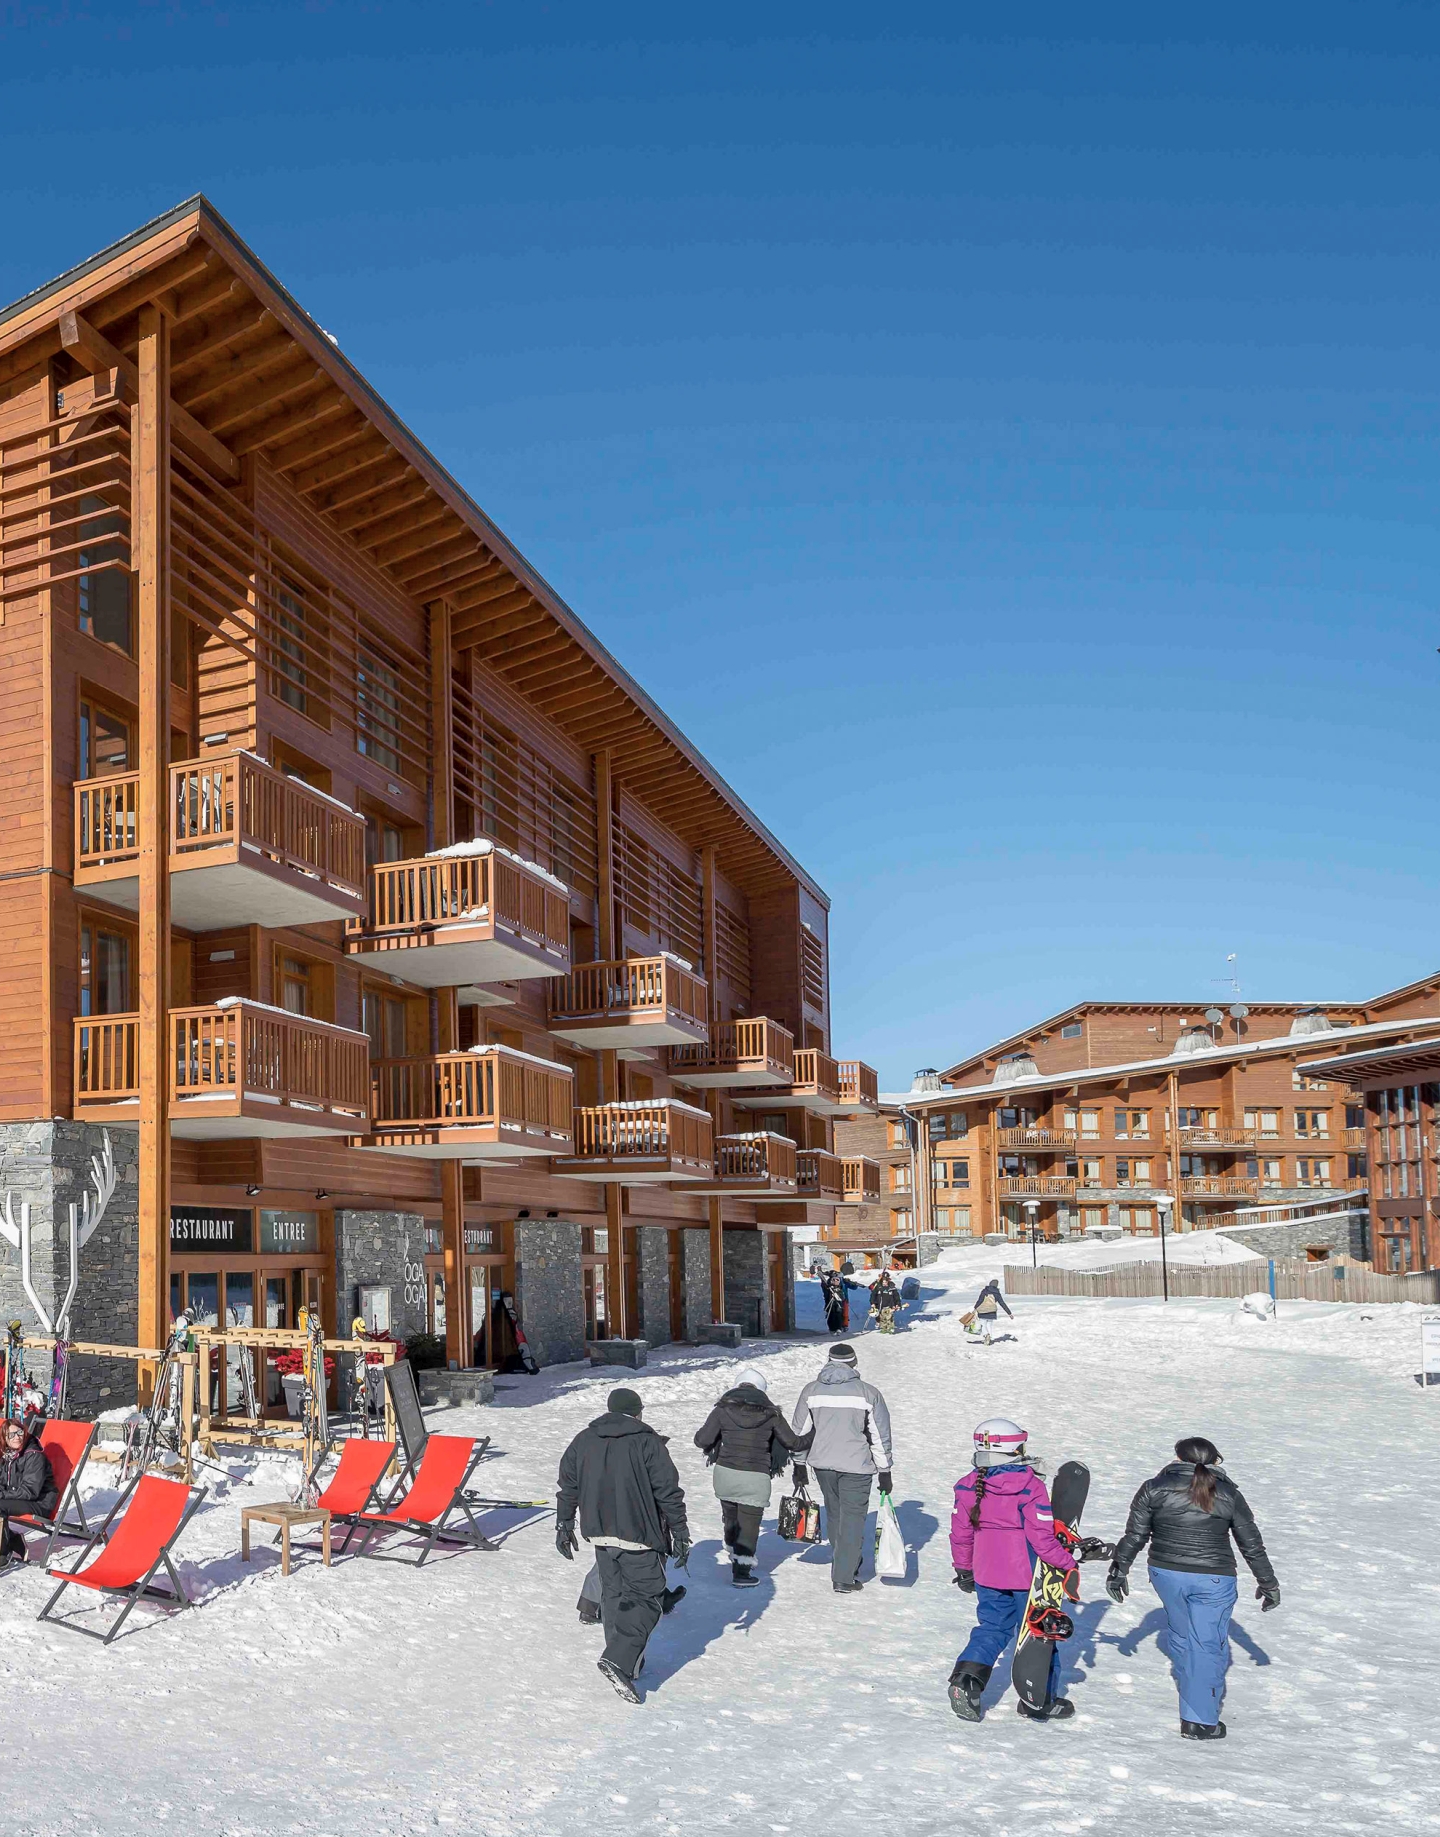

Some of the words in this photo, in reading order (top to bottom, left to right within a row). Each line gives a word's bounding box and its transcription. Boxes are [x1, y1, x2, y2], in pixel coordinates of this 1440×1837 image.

[170, 1218, 234, 1240] RESTAURANT
[273, 1222, 305, 1241] ENTREE
[464, 1229, 493, 1244] ESTAURANT
